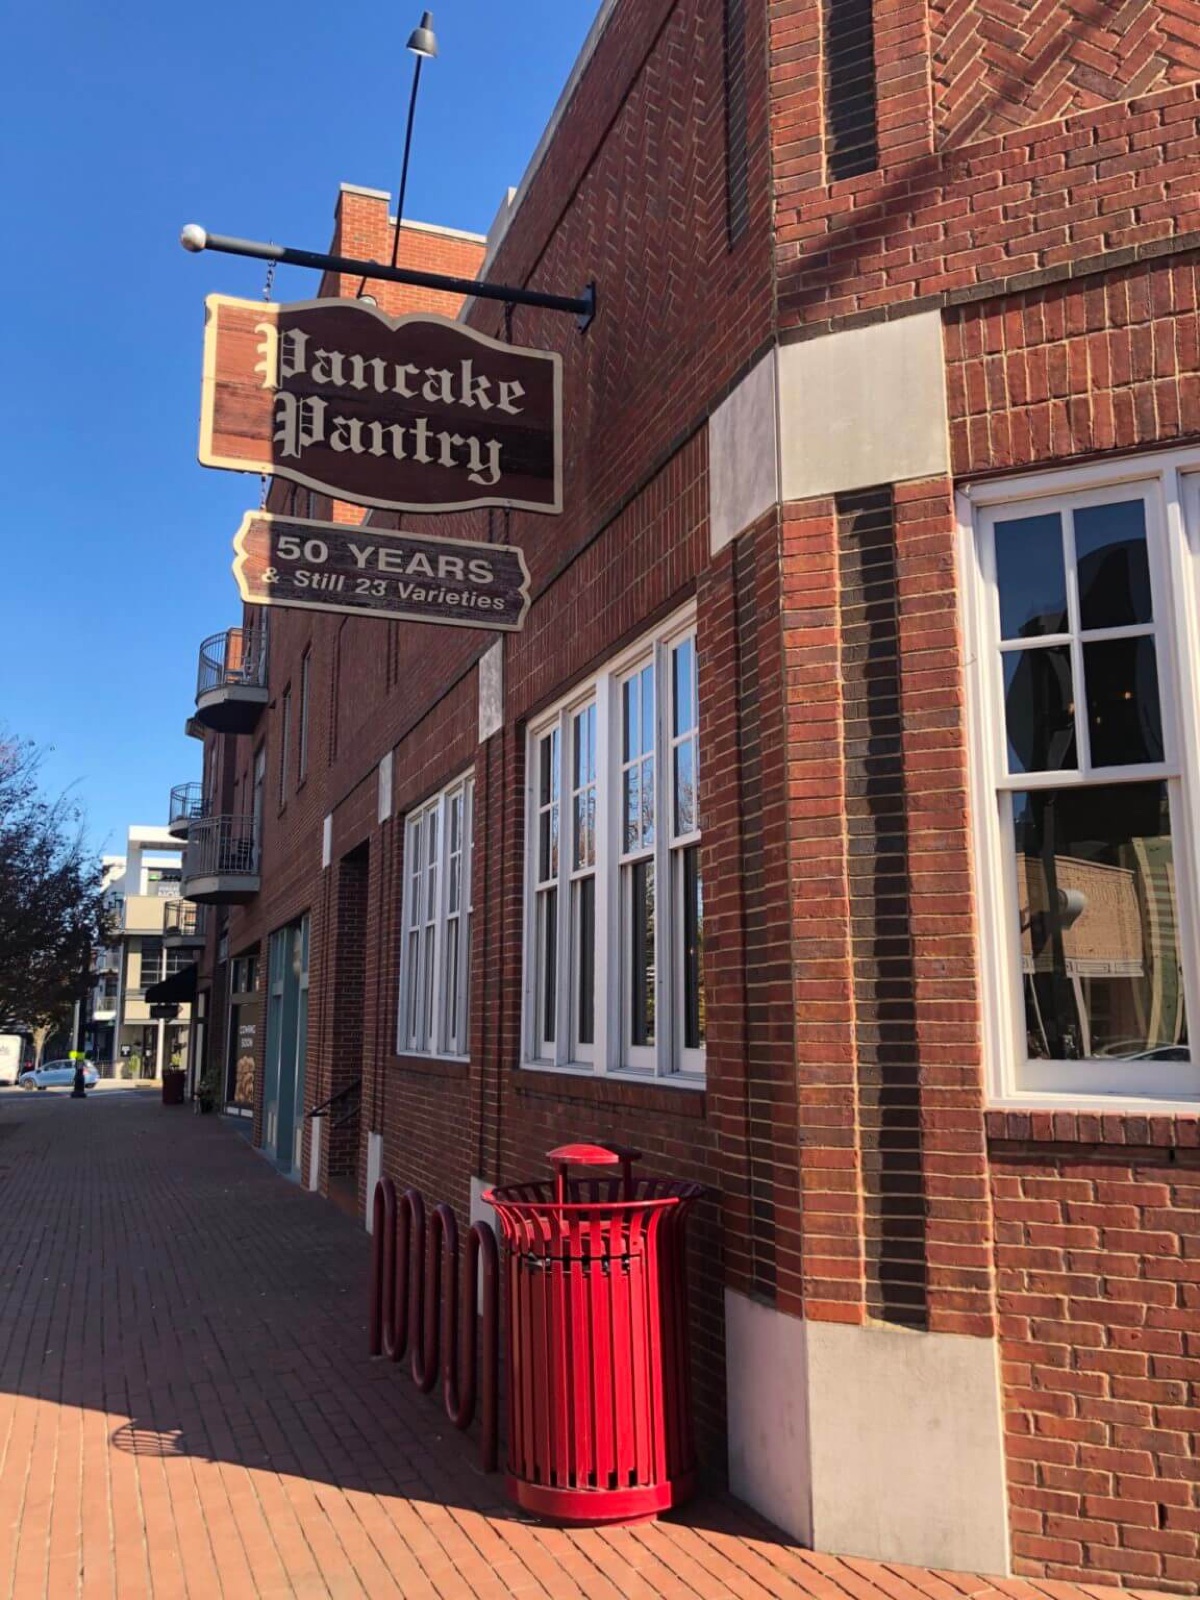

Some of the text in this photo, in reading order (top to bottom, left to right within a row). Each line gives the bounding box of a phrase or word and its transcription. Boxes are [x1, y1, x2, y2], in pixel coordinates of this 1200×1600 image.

[254, 323, 526, 415] Pancake
[273, 393, 503, 485] Pantry
[261, 567, 506, 611] & Still 23 Varieties
[276, 536, 494, 584] 50 YEARS
